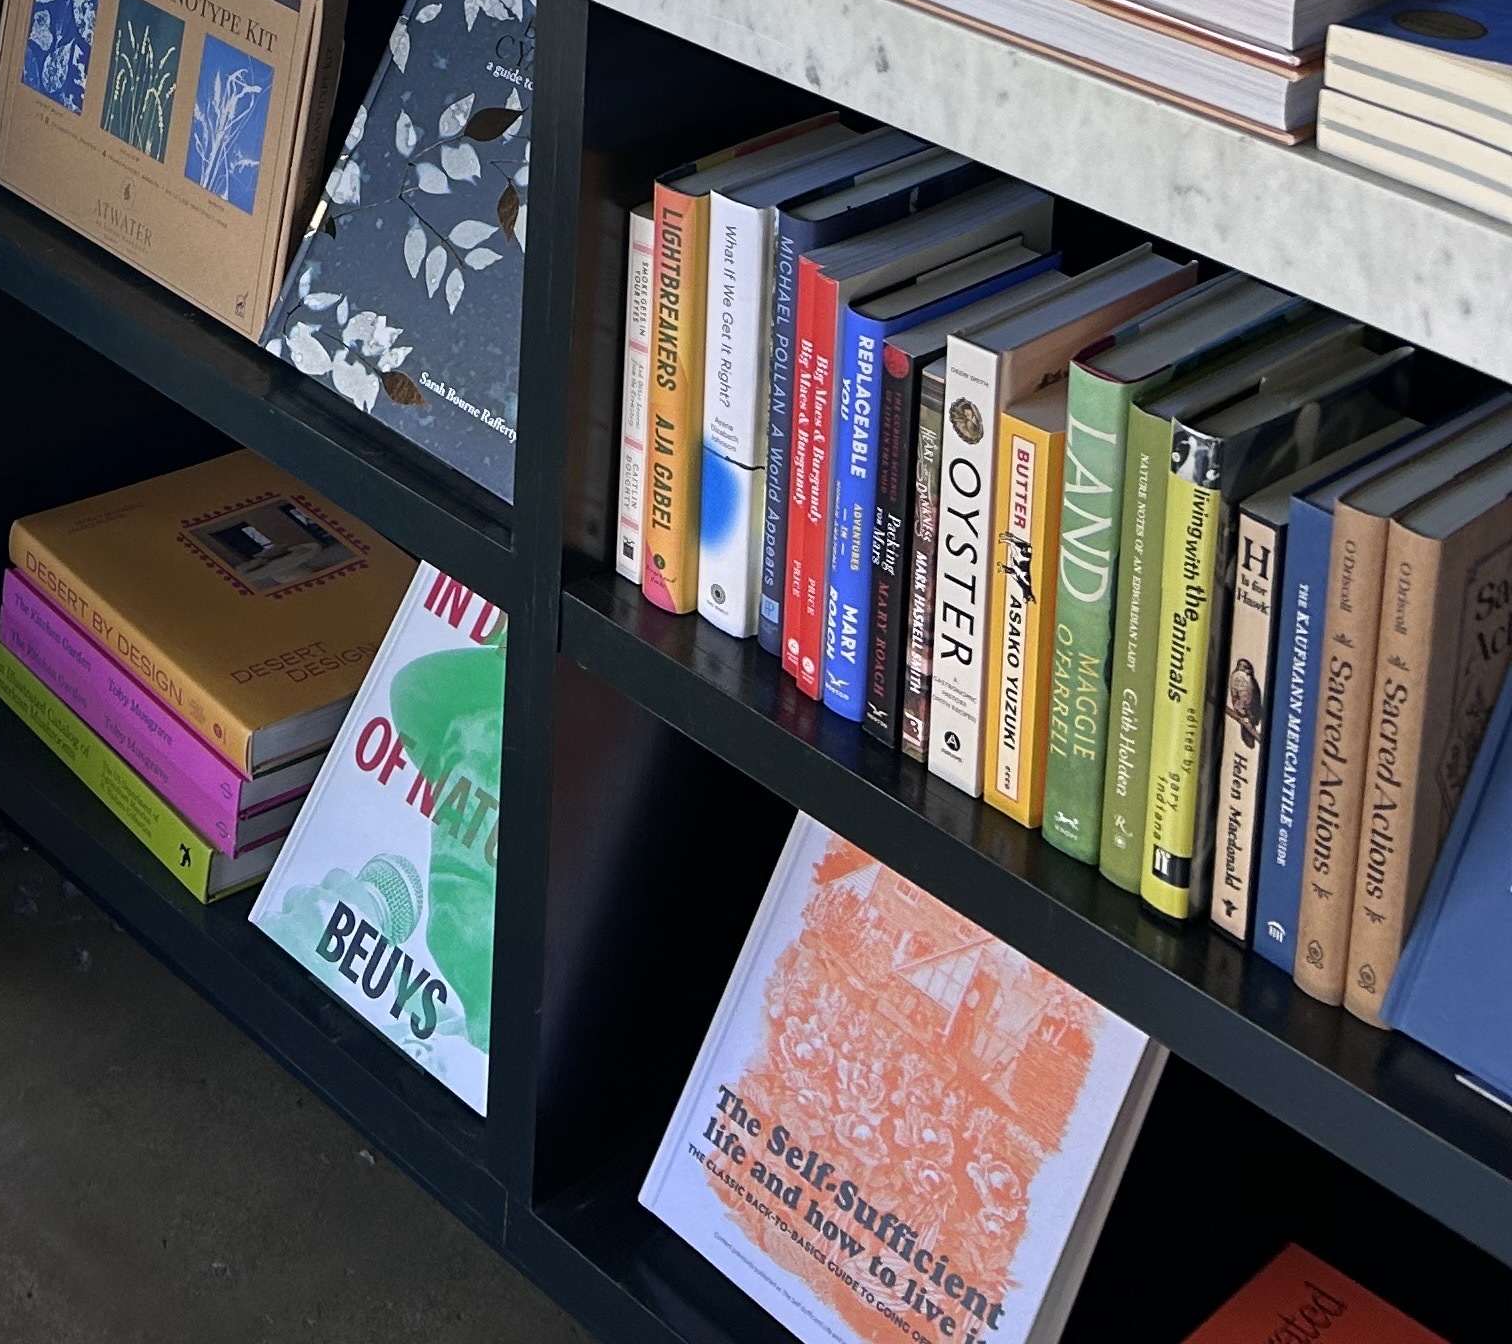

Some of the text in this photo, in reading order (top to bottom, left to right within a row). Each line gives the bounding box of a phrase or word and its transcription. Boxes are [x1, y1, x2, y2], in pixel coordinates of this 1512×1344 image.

[245, 17, 279, 54] KIT
[486, 61, 523, 85] a guide
[657, 206, 684, 393] LIGHTBREAKERS
[716, 224, 738, 408] What If We Get It Right?
[418, 371, 518, 444] Sarah Bourne Rafferty
[762, 235, 794, 587] MICHAEL POLLAN A World Appears
[792, 338, 814, 509] Big Macs & Burgundy
[808, 354, 828, 527] Big Macs & Burgundy
[840, 378, 852, 422] YOU
[849, 334, 875, 480] REPLACEABLE
[652, 414, 676, 531] AJA GABEL
[1013, 448, 1030, 531] BUTTER
[1058, 412, 1118, 604] LAND
[790, 559, 802, 597] PRICE
[850, 503, 864, 572] ADVENTURES
[872, 523, 886, 566] Mars
[879, 513, 904, 578] Packing
[940, 457, 982, 667] OYSTER
[1127, 452, 1150, 672] NATURE NOTES OF AN EDWARDIAN LADY
[1184, 487, 1212, 623] living with the
[1242, 535, 1271, 582] H
[26, 550, 183, 706] DESERT BY DESIGN
[806, 577, 817, 616] PRICE
[826, 584, 838, 660] ROACH
[840, 603, 860, 665] MARY
[870, 580, 890, 698] MARY ROACH
[908, 550, 928, 696] MARK HASKELL SMITH
[1236, 588, 1270, 615] Hawk
[231, 640, 326, 686] DESERT
[286, 641, 378, 685] DESIGN
[1003, 594, 1023, 752] ASAKO YUZUKI
[1048, 622, 1074, 758] O'FARRELL
[1073, 650, 1100, 762] MAGGIE
[1168, 612, 1190, 704] animals
[355, 716, 412, 787] OF
[1116, 688, 1138, 799] Edith Holden
[1182, 708, 1196, 775] edited by
[1275, 583, 1310, 868] THE KAUFMANN MERCANTILE GUIDE
[1310, 656, 1353, 874] Sacred Actions
[1154, 775, 1168, 842] indiana
[1170, 772, 1181, 813] gary
[1224, 751, 1248, 893] Helen Macdonald
[1364, 677, 1408, 899] Sacred Actions
[316, 900, 448, 1041] BEUYS
[688, 1144, 914, 1332] THE CLASSIC BACK-TO-BASICS GUIDE TO GOING
[702, 1118, 747, 1162] life
[749, 1146, 798, 1209] and
[803, 1199, 866, 1260] how
[868, 1246, 898, 1288] to
[900, 1274, 957, 1342] live
[716, 1084, 760, 1138] The
[766, 1124, 1006, 1330] Self-Sufficient
